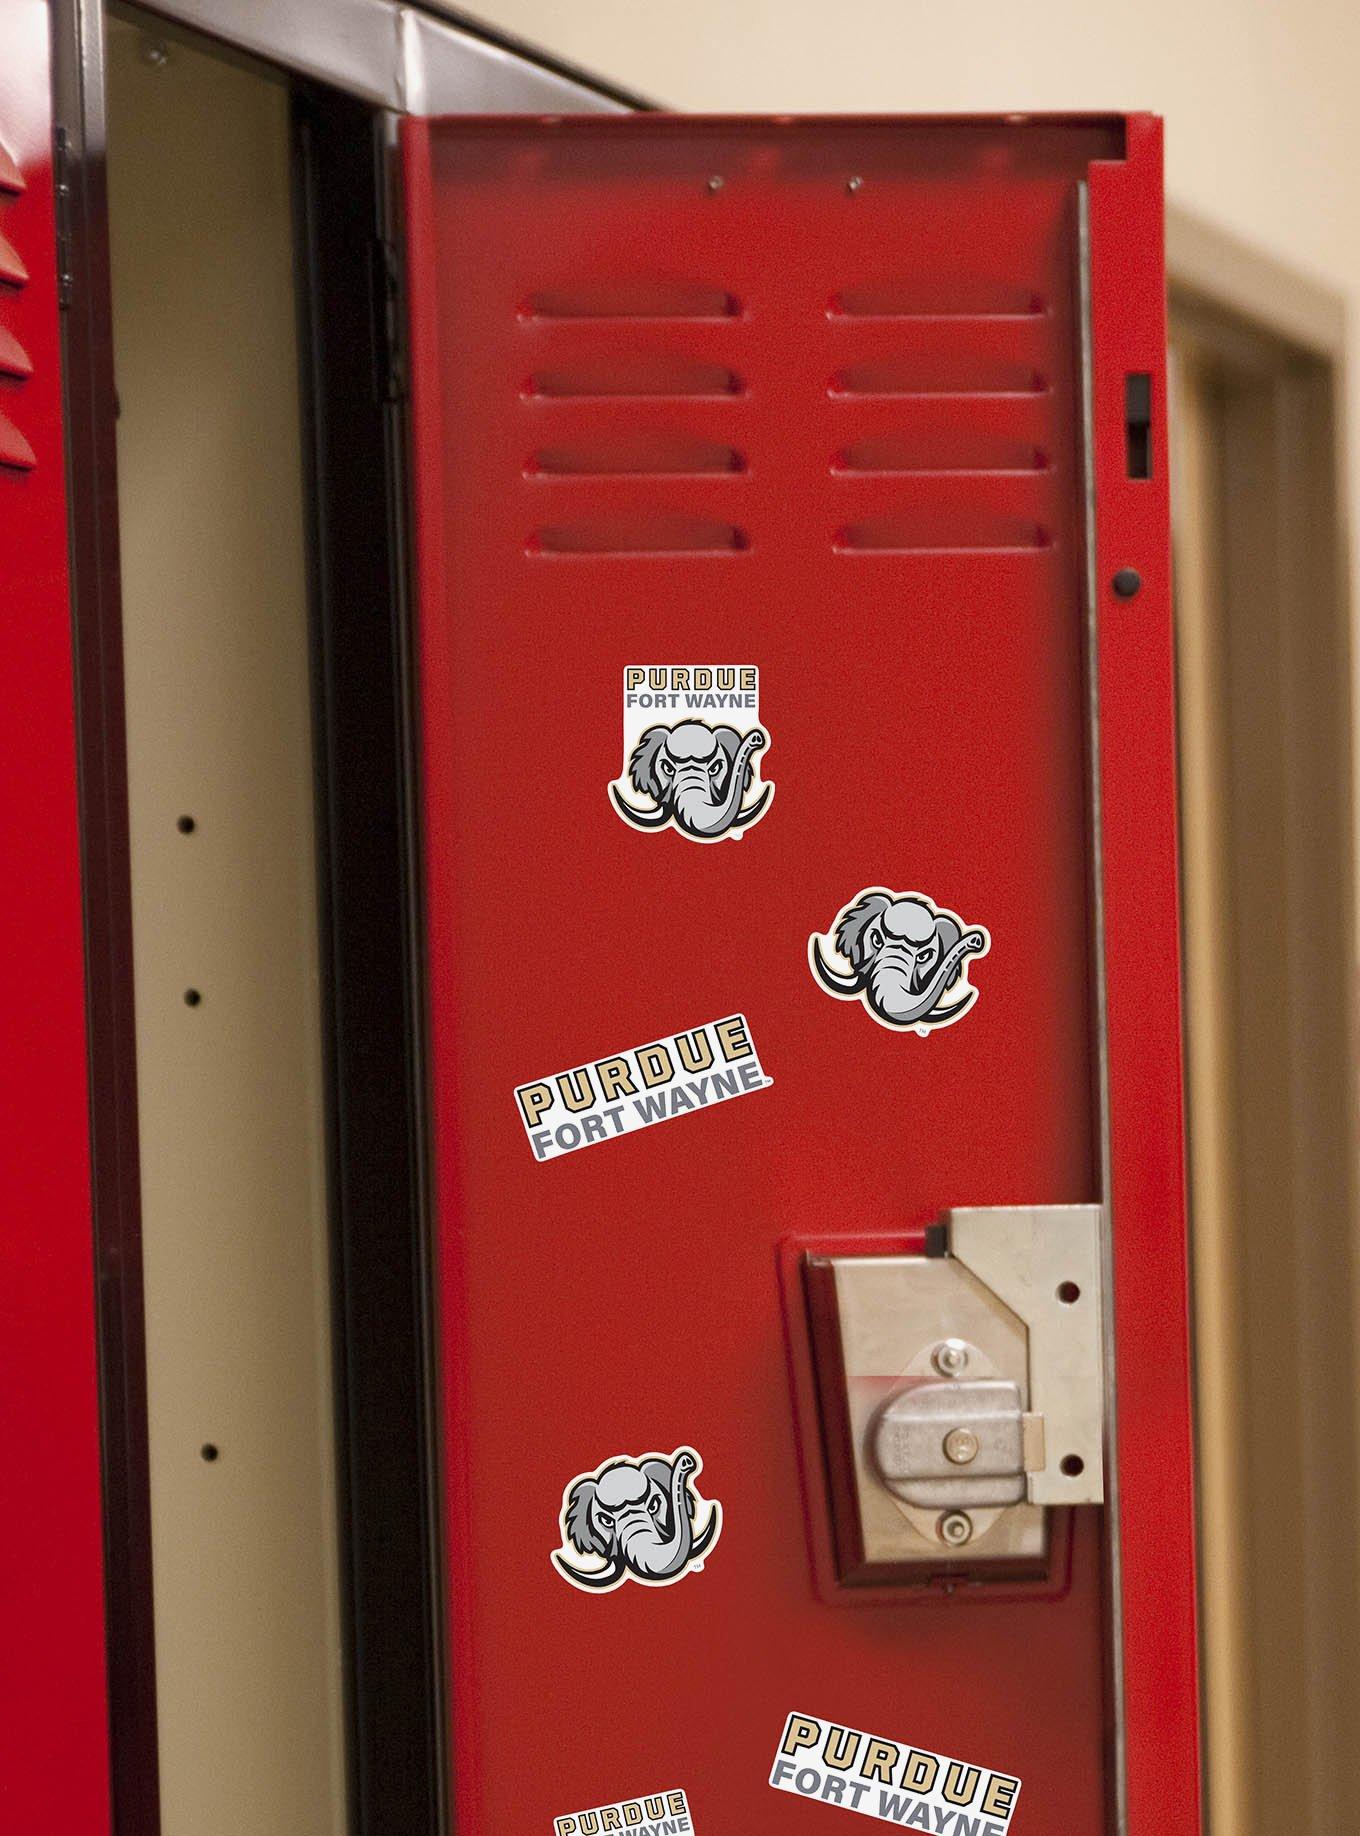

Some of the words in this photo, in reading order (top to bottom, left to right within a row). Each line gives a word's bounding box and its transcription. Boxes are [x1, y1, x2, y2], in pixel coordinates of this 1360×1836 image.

[626, 668, 756, 691] PURDUE
[626, 693, 680, 709] FORT
[684, 693, 756, 709] WAYNE
[517, 1016, 753, 1129] PURDUE
[531, 1105, 625, 1159] FORT
[632, 1061, 763, 1124] WAYNE
[772, 1759, 871, 1809] FORT
[781, 1714, 1019, 1820] PURDUE
[557, 1791, 686, 1836] PURDUE
